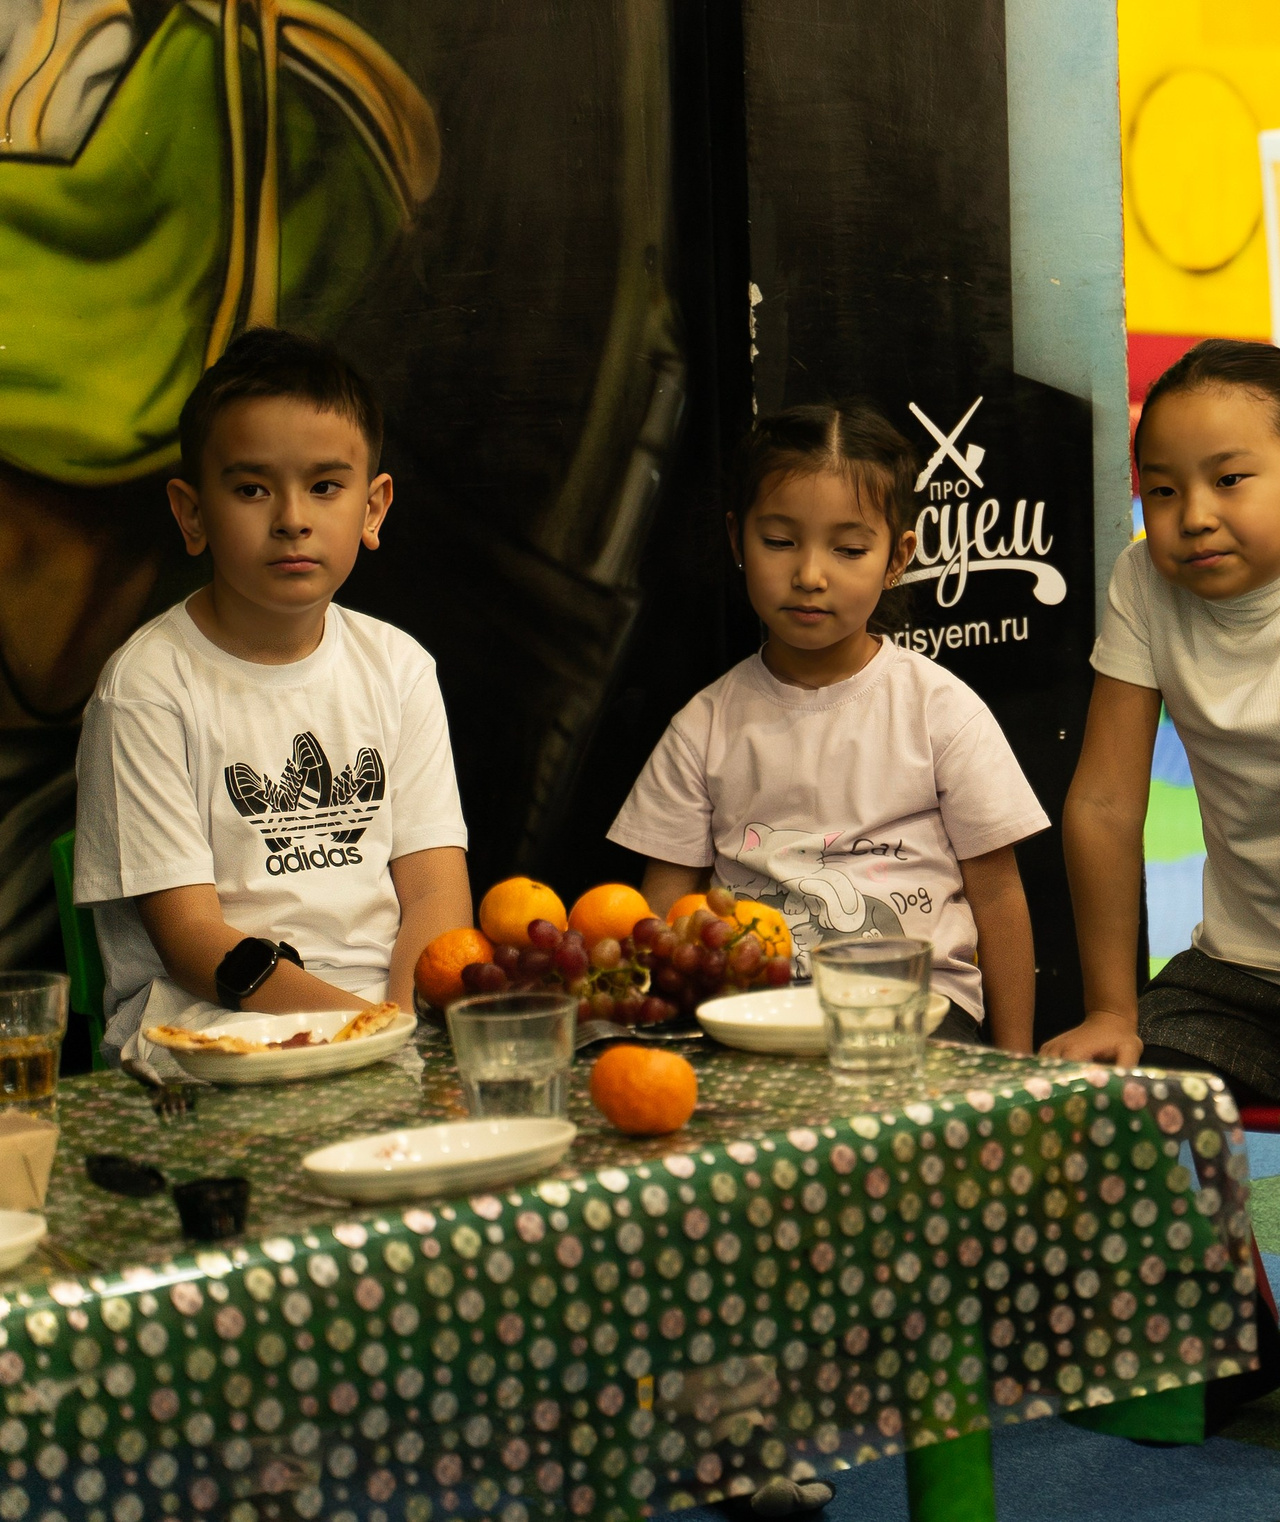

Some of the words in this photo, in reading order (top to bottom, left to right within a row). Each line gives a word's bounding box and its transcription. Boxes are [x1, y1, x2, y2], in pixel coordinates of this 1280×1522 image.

[930, 479, 970, 501] ПРО
[907, 498, 1053, 608] суем
[266, 844, 363, 876] adidas
[849, 838, 908, 861] Cat
[889, 887, 932, 915] Dog
